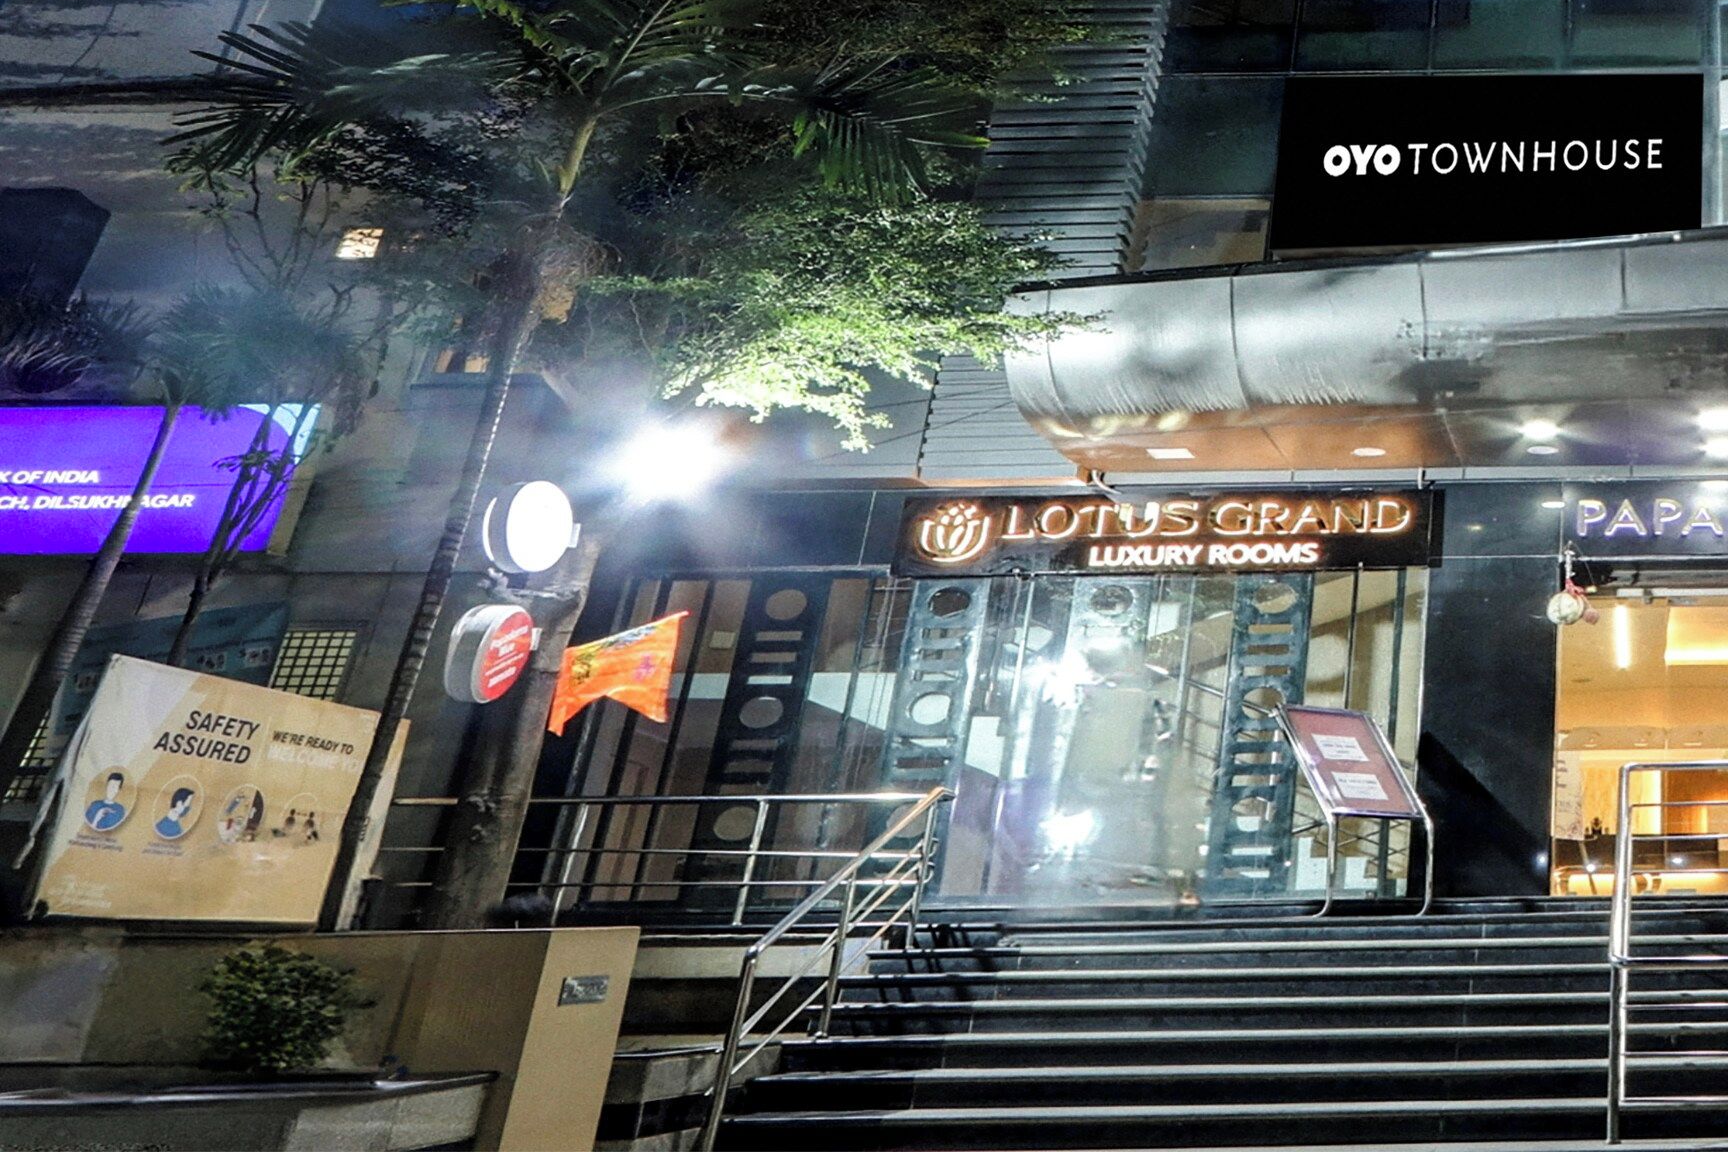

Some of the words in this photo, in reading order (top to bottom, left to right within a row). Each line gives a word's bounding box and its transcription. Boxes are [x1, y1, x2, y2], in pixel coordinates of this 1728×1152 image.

[1323, 144, 1401, 177] OYO
[1407, 138, 1664, 174] TOWNHOUSE
[12, 470, 44, 484] OF
[43, 470, 99, 484] INDIA
[1001, 501, 1199, 538] LOTUS
[1210, 499, 1411, 536] GRAND
[1088, 543, 1203, 568] LUXURY
[1208, 542, 1320, 566] ROOMS
[185, 710, 260, 741] SAFETY
[153, 731, 252, 764] ASSURED
[304, 736, 339, 752] READY
[340, 743, 354, 755] TO
